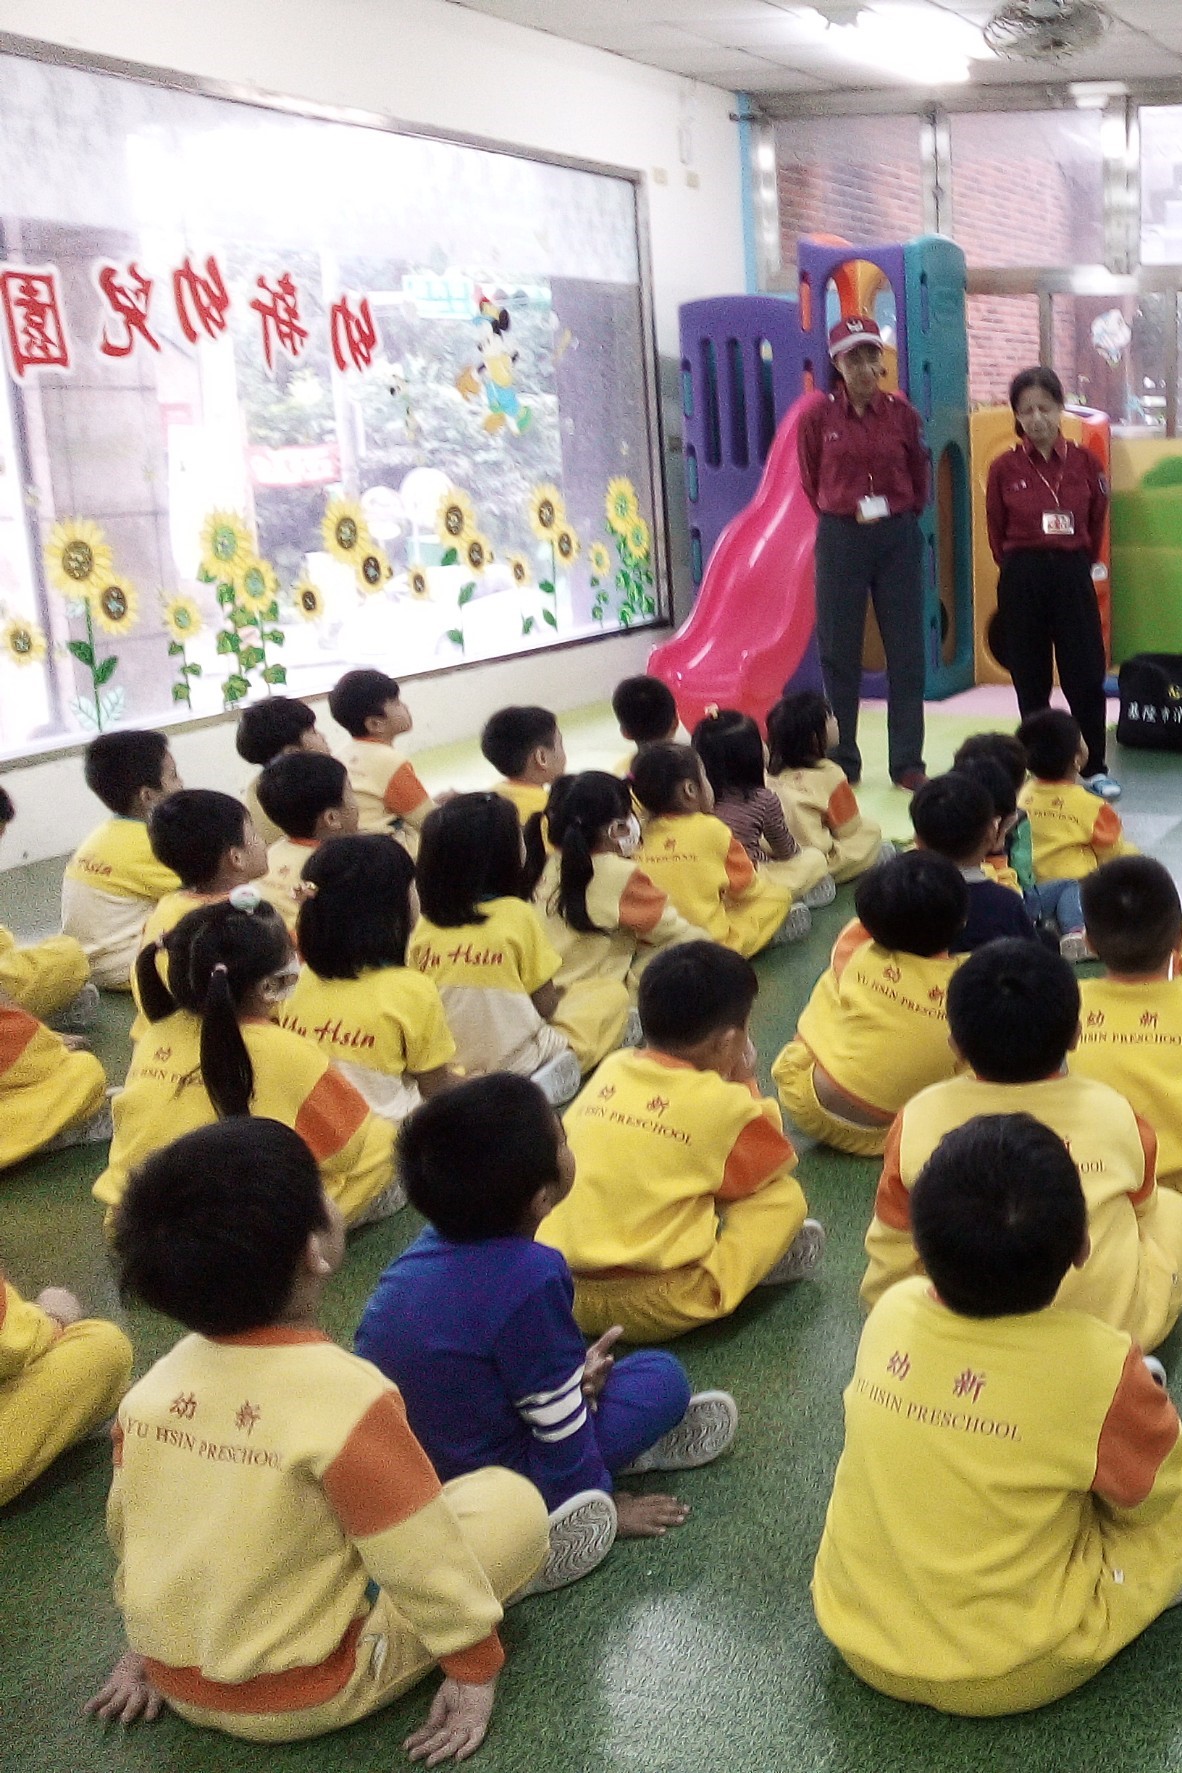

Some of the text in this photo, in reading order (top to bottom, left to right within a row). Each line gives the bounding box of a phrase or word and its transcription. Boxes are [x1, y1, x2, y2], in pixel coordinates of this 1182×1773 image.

[448, 943, 503, 966] Hsin
[314, 1017, 375, 1048] Hsin
[609, 1110, 692, 1147] PRESCHOOL
[887, 1350, 987, 1405] 幼 新
[169, 1391, 262, 1438] 幼 新
[869, 1384, 904, 1414] HSIN
[906, 1402, 1023, 1443] PRESCHOOL
[155, 1425, 197, 1453] HSIN
